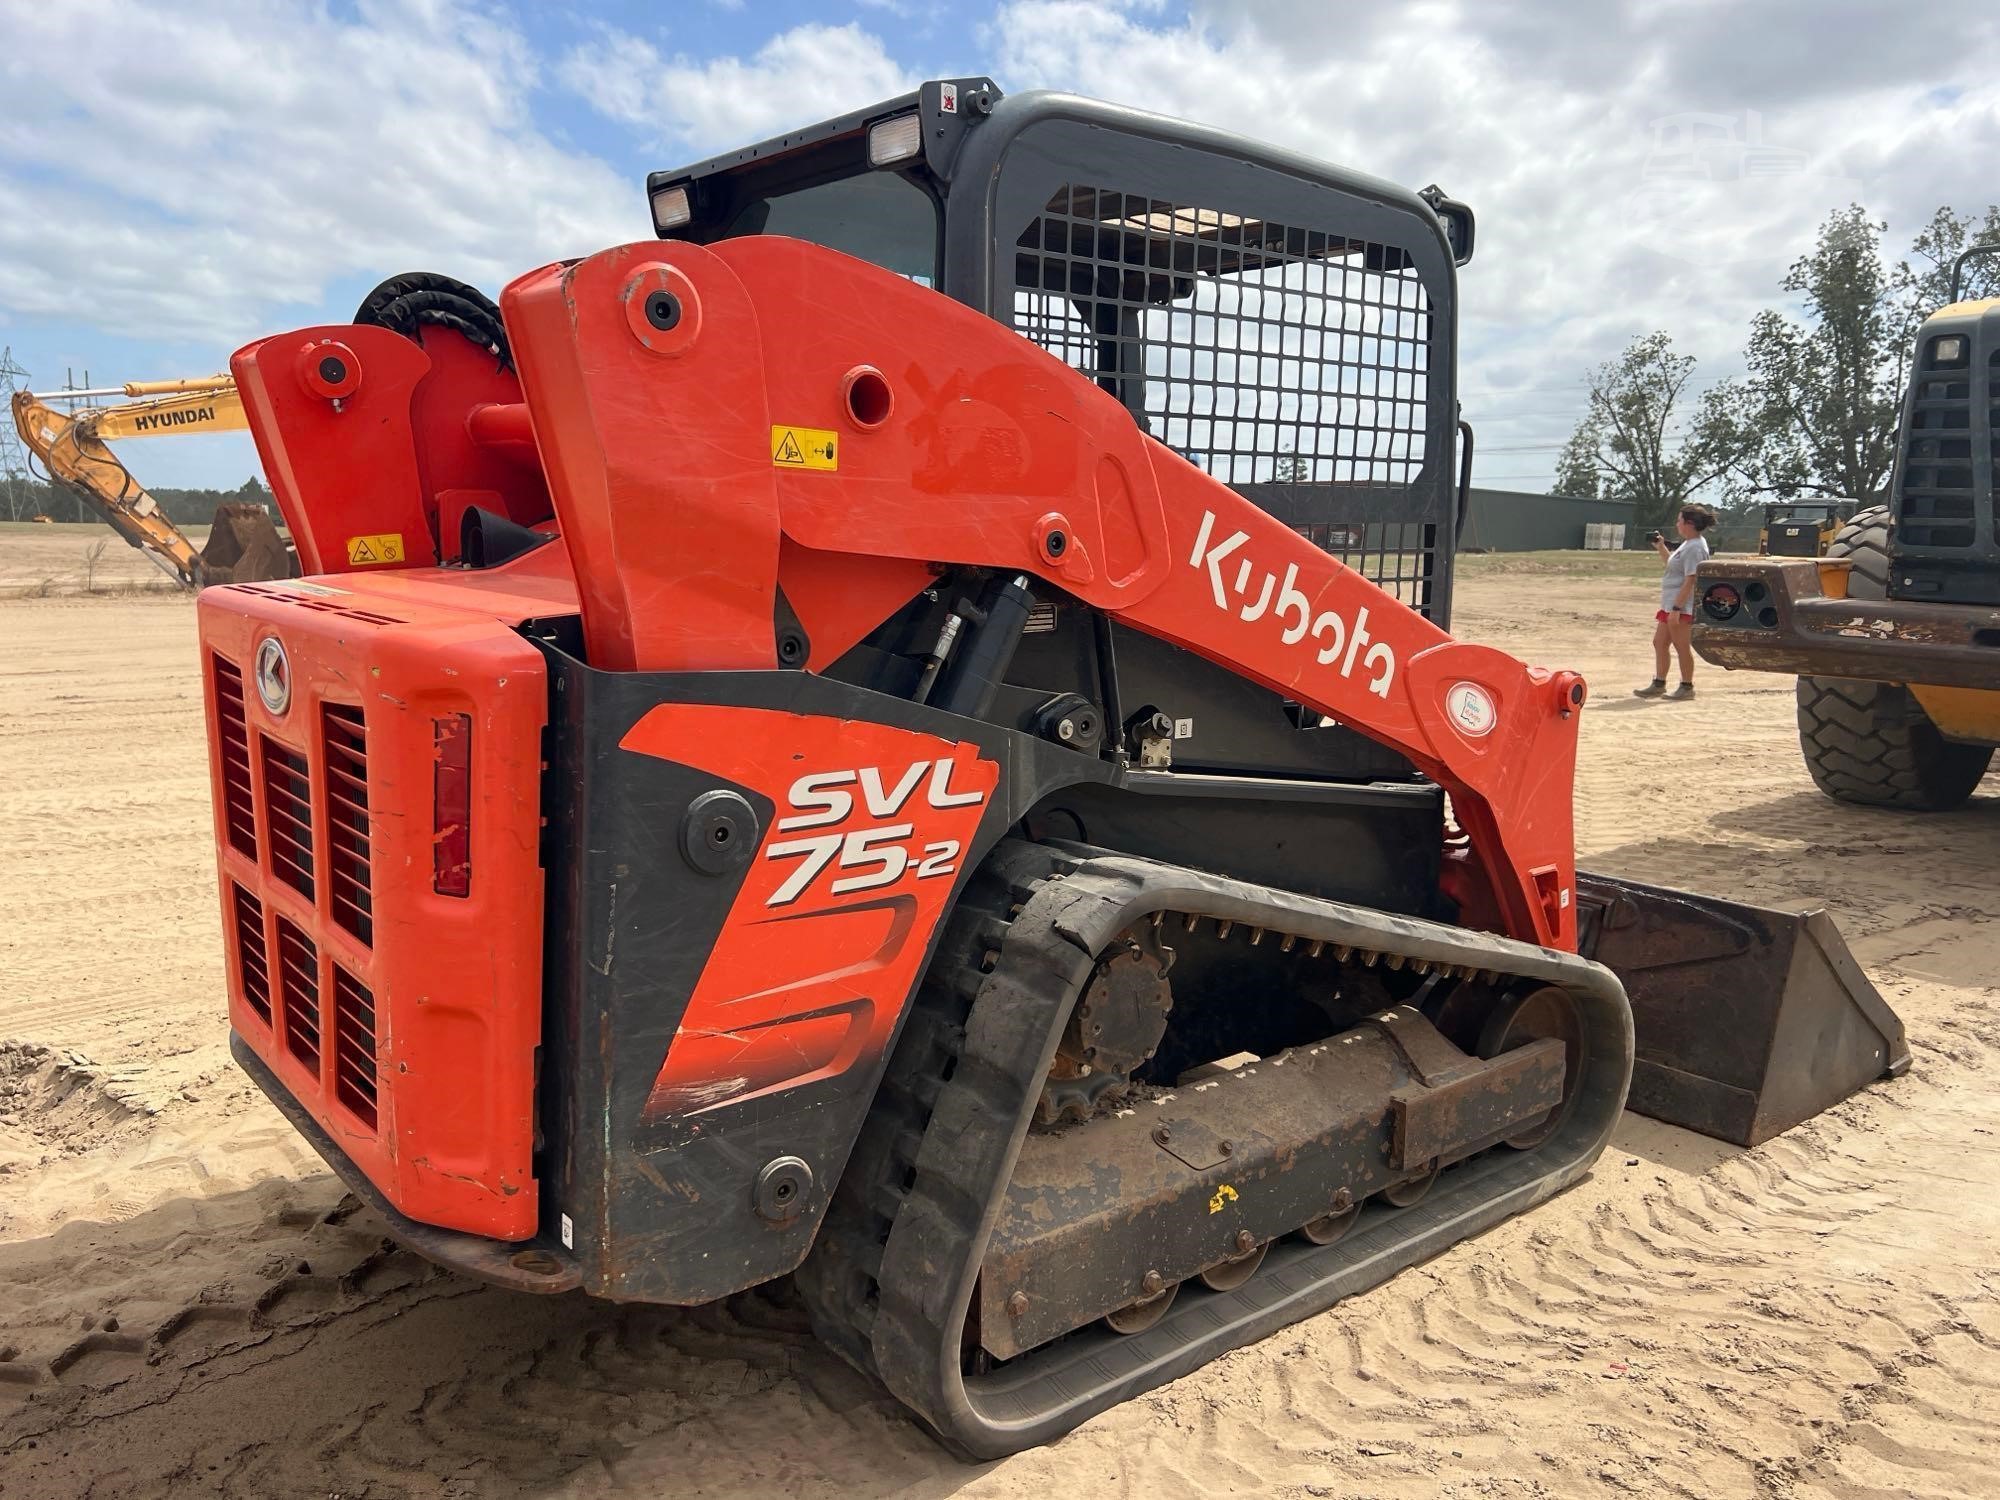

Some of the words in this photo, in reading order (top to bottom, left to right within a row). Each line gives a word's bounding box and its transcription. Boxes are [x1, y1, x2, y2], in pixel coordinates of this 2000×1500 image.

[135, 407, 215, 431] HYUNDAI
[1786, 528, 1800, 536] CAT
[1189, 509, 1396, 699] Kubota
[777, 758, 984, 832] SVL
[765, 823, 960, 908] 75-2
